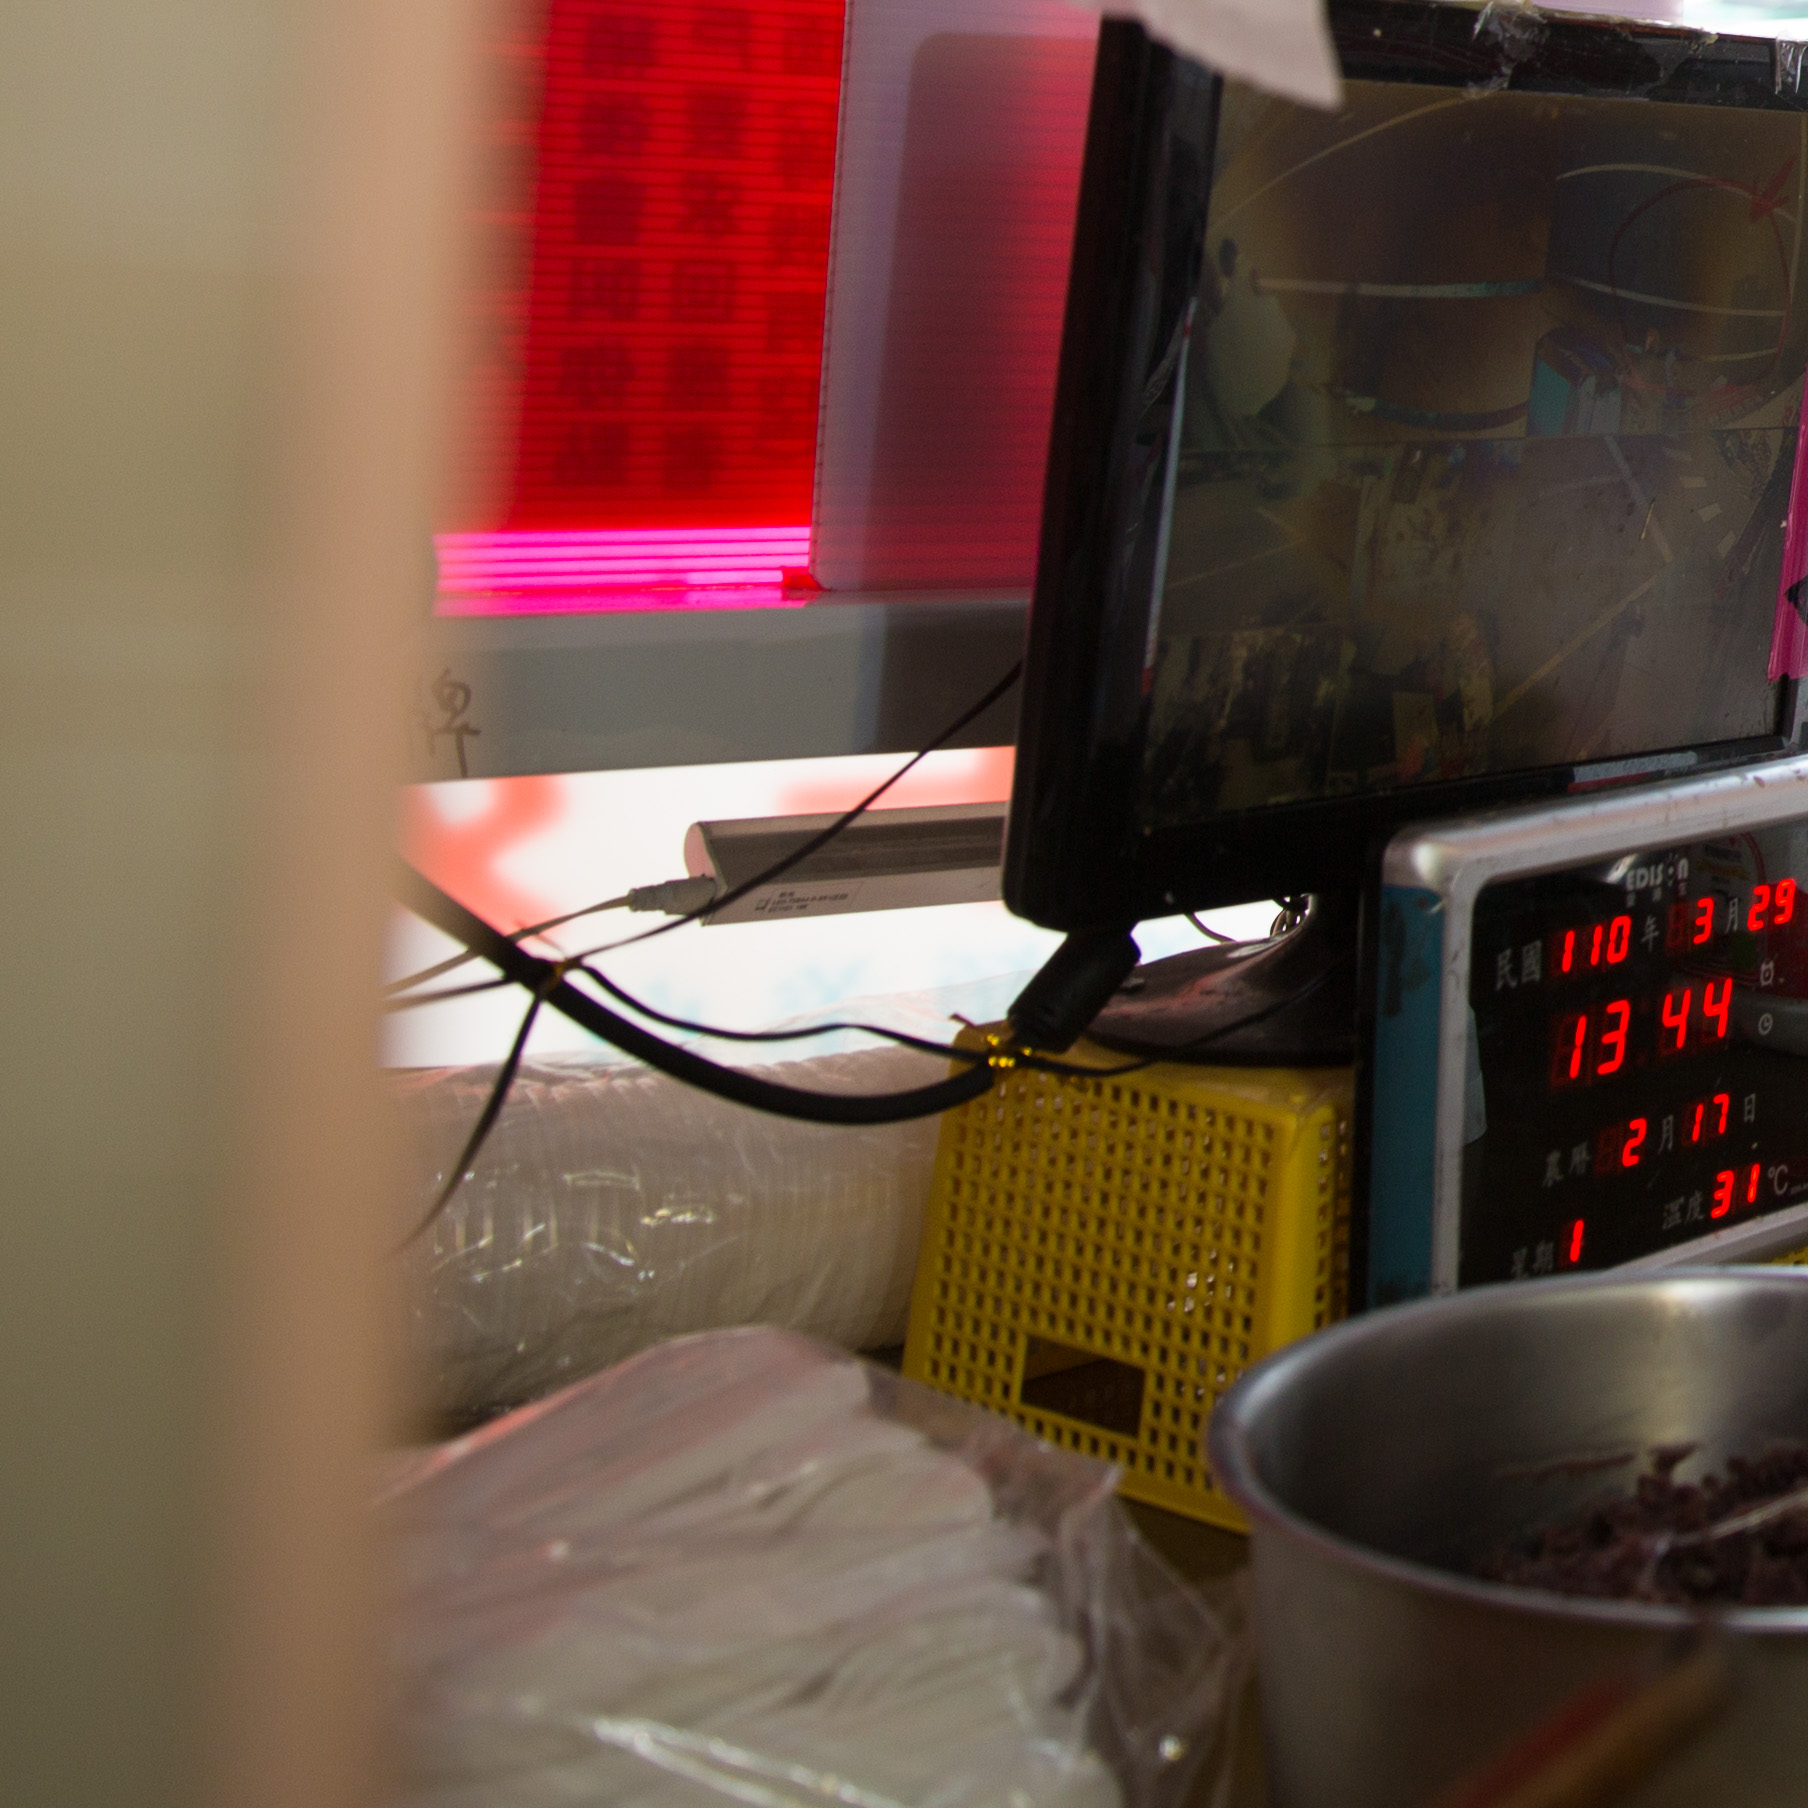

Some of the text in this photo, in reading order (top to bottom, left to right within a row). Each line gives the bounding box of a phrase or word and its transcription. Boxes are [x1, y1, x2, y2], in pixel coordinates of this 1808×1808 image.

[1561, 915, 1632, 973] 110
[1693, 896, 1715, 945] 3
[1724, 897, 1741, 934] 月
[1747, 878, 1797, 932] 29
[1622, 1117, 1648, 1168] 2
[1691, 1092, 1731, 1142] 17
[1709, 1162, 1761, 1219] 31
[1569, 1218, 1585, 1263] 1
